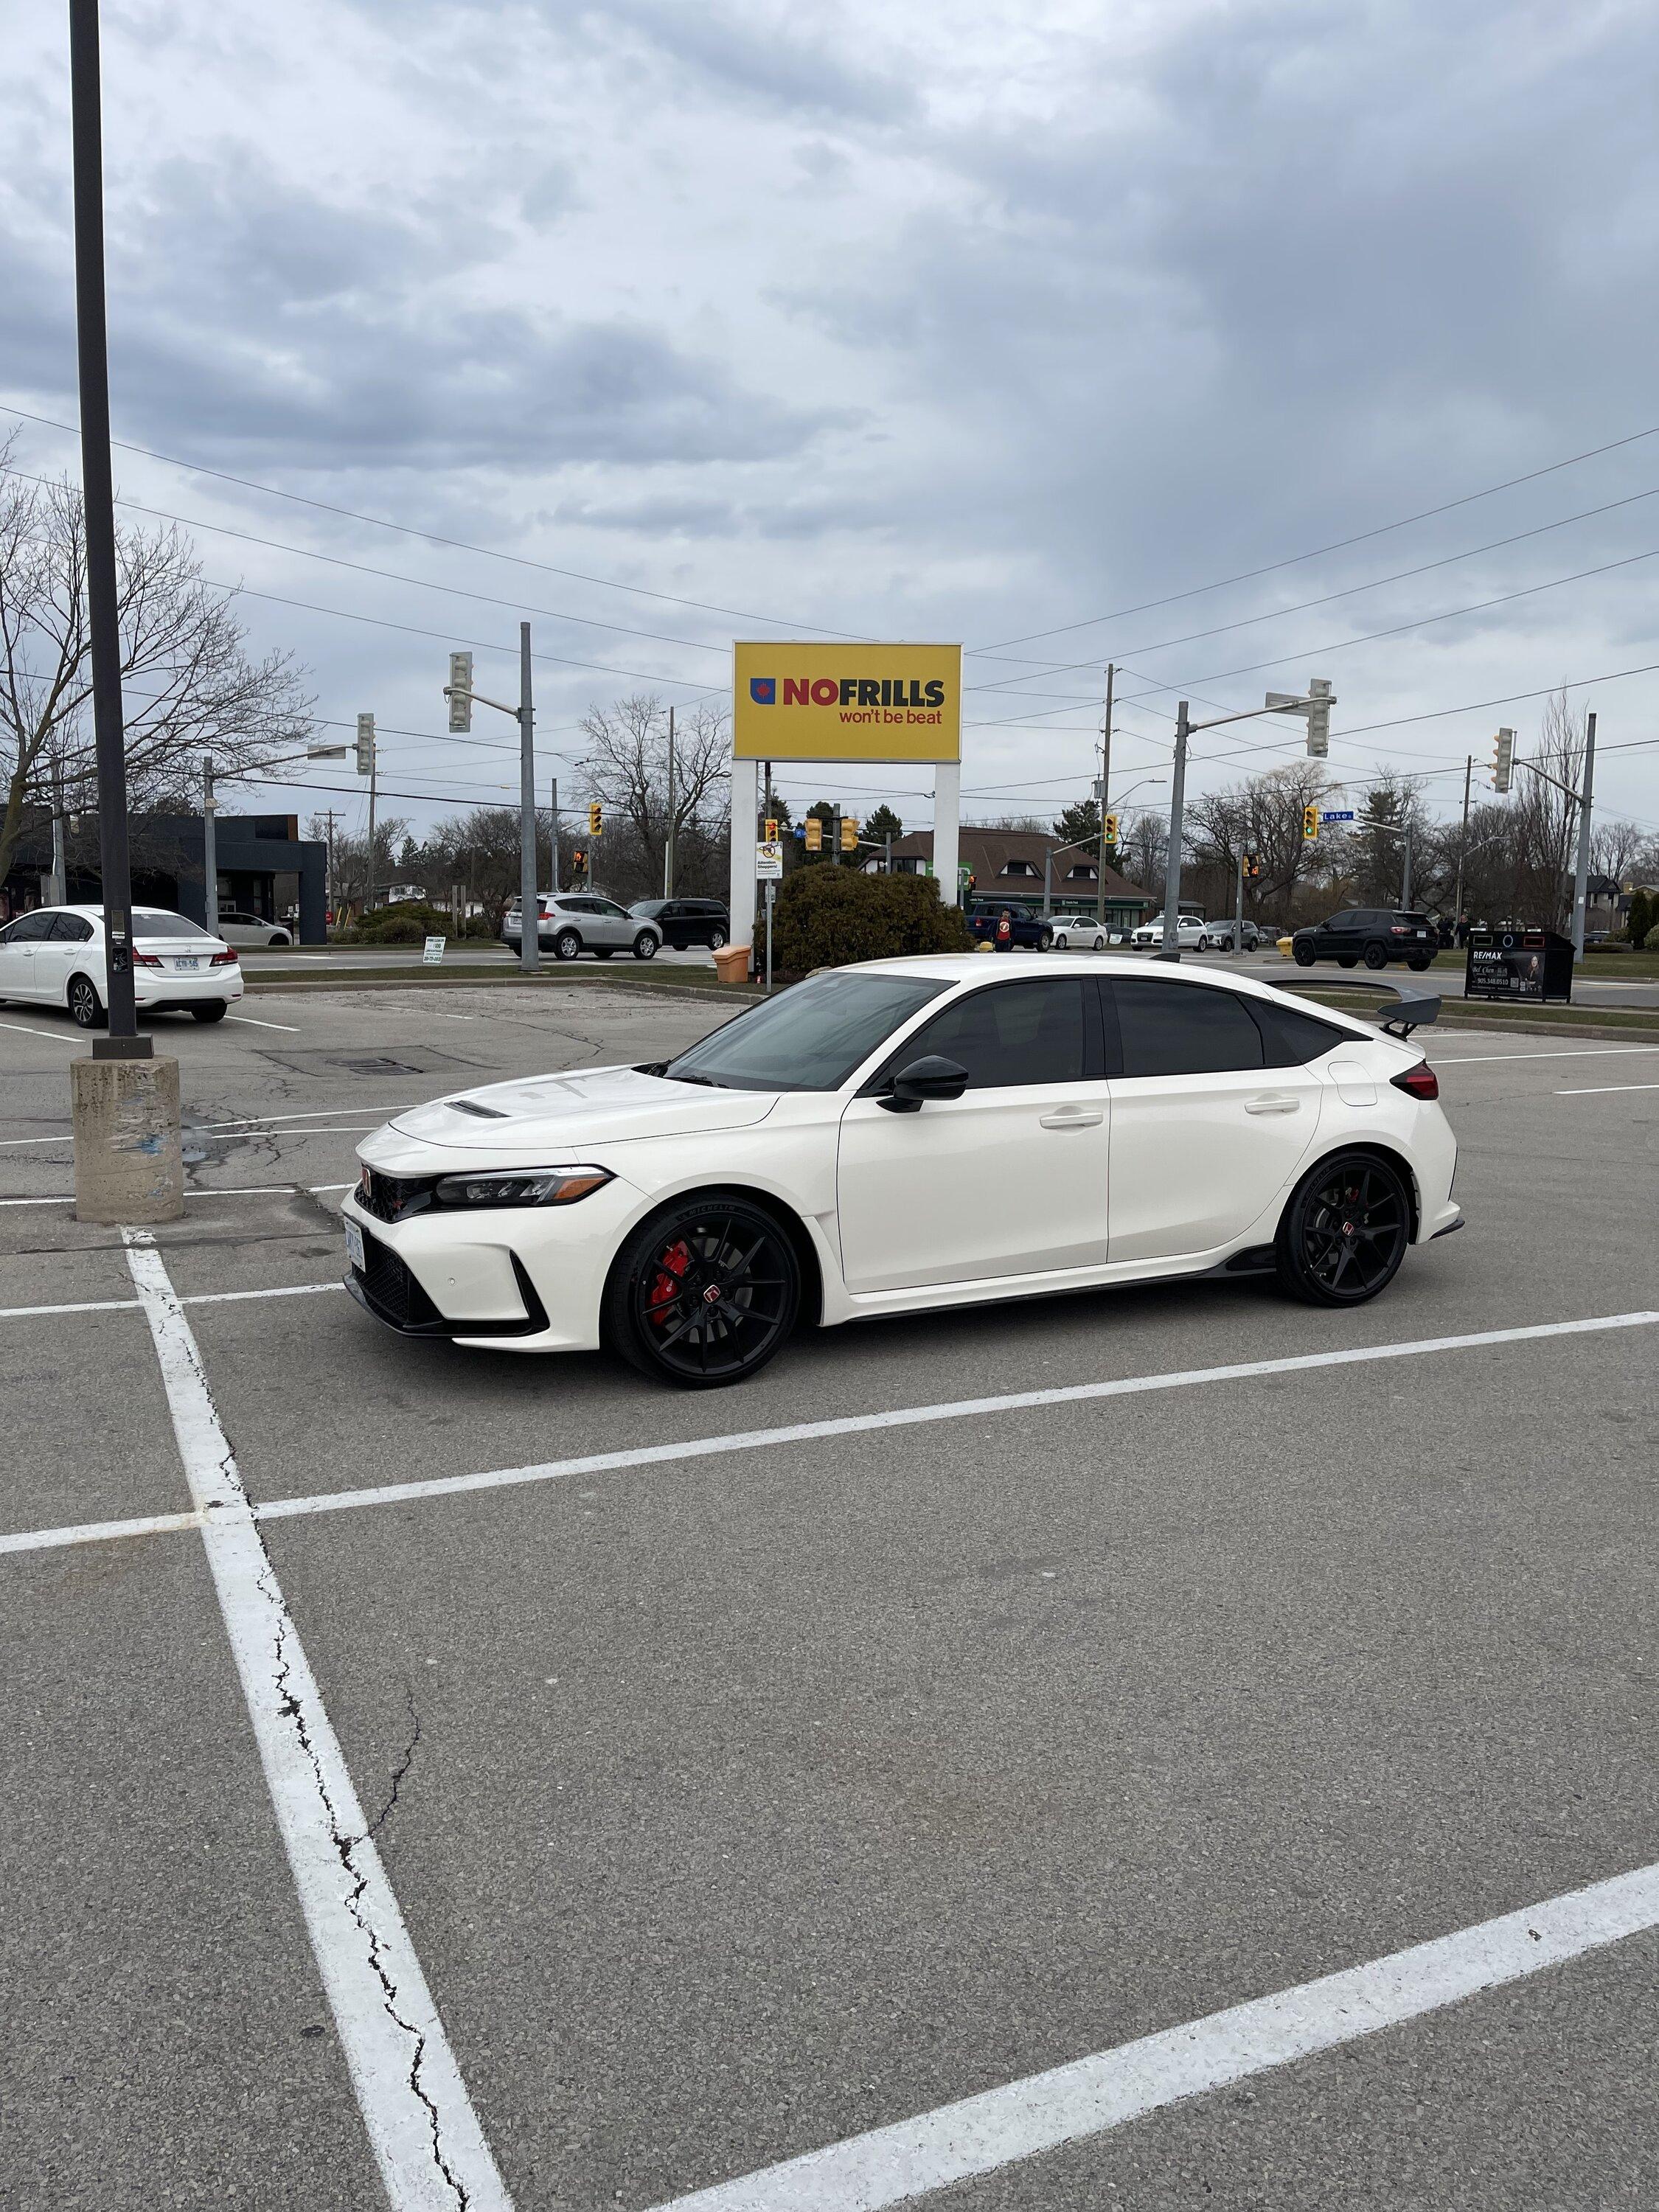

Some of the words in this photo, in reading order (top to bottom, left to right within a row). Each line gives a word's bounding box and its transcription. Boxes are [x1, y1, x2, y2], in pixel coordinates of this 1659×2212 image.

[839, 709, 880, 723] won't
[884, 709, 903, 723] be
[906, 709, 942, 724] beat
[1473, 951, 1503, 960] RE/MAX
[689, 1204, 736, 1217] MICHELIN
